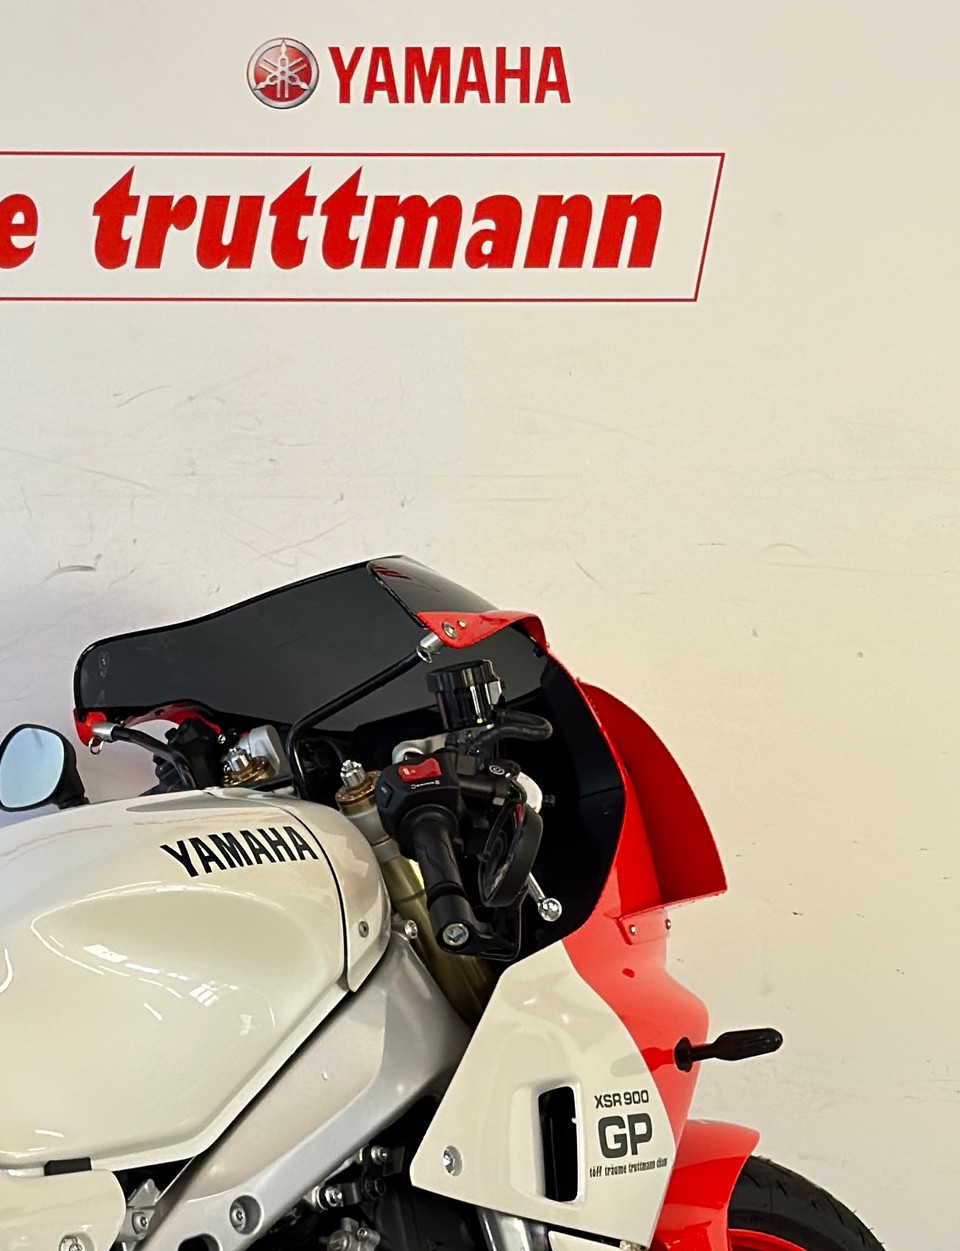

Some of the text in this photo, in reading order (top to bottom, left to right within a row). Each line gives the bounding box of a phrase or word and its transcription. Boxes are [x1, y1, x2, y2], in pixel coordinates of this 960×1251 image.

[328, 46, 571, 104] YAMAHA
[92, 166, 663, 271] truttmann
[159, 826, 319, 877] YAMAHA
[594, 1089, 650, 1109] XSR 900
[597, 1112, 653, 1159] GP
